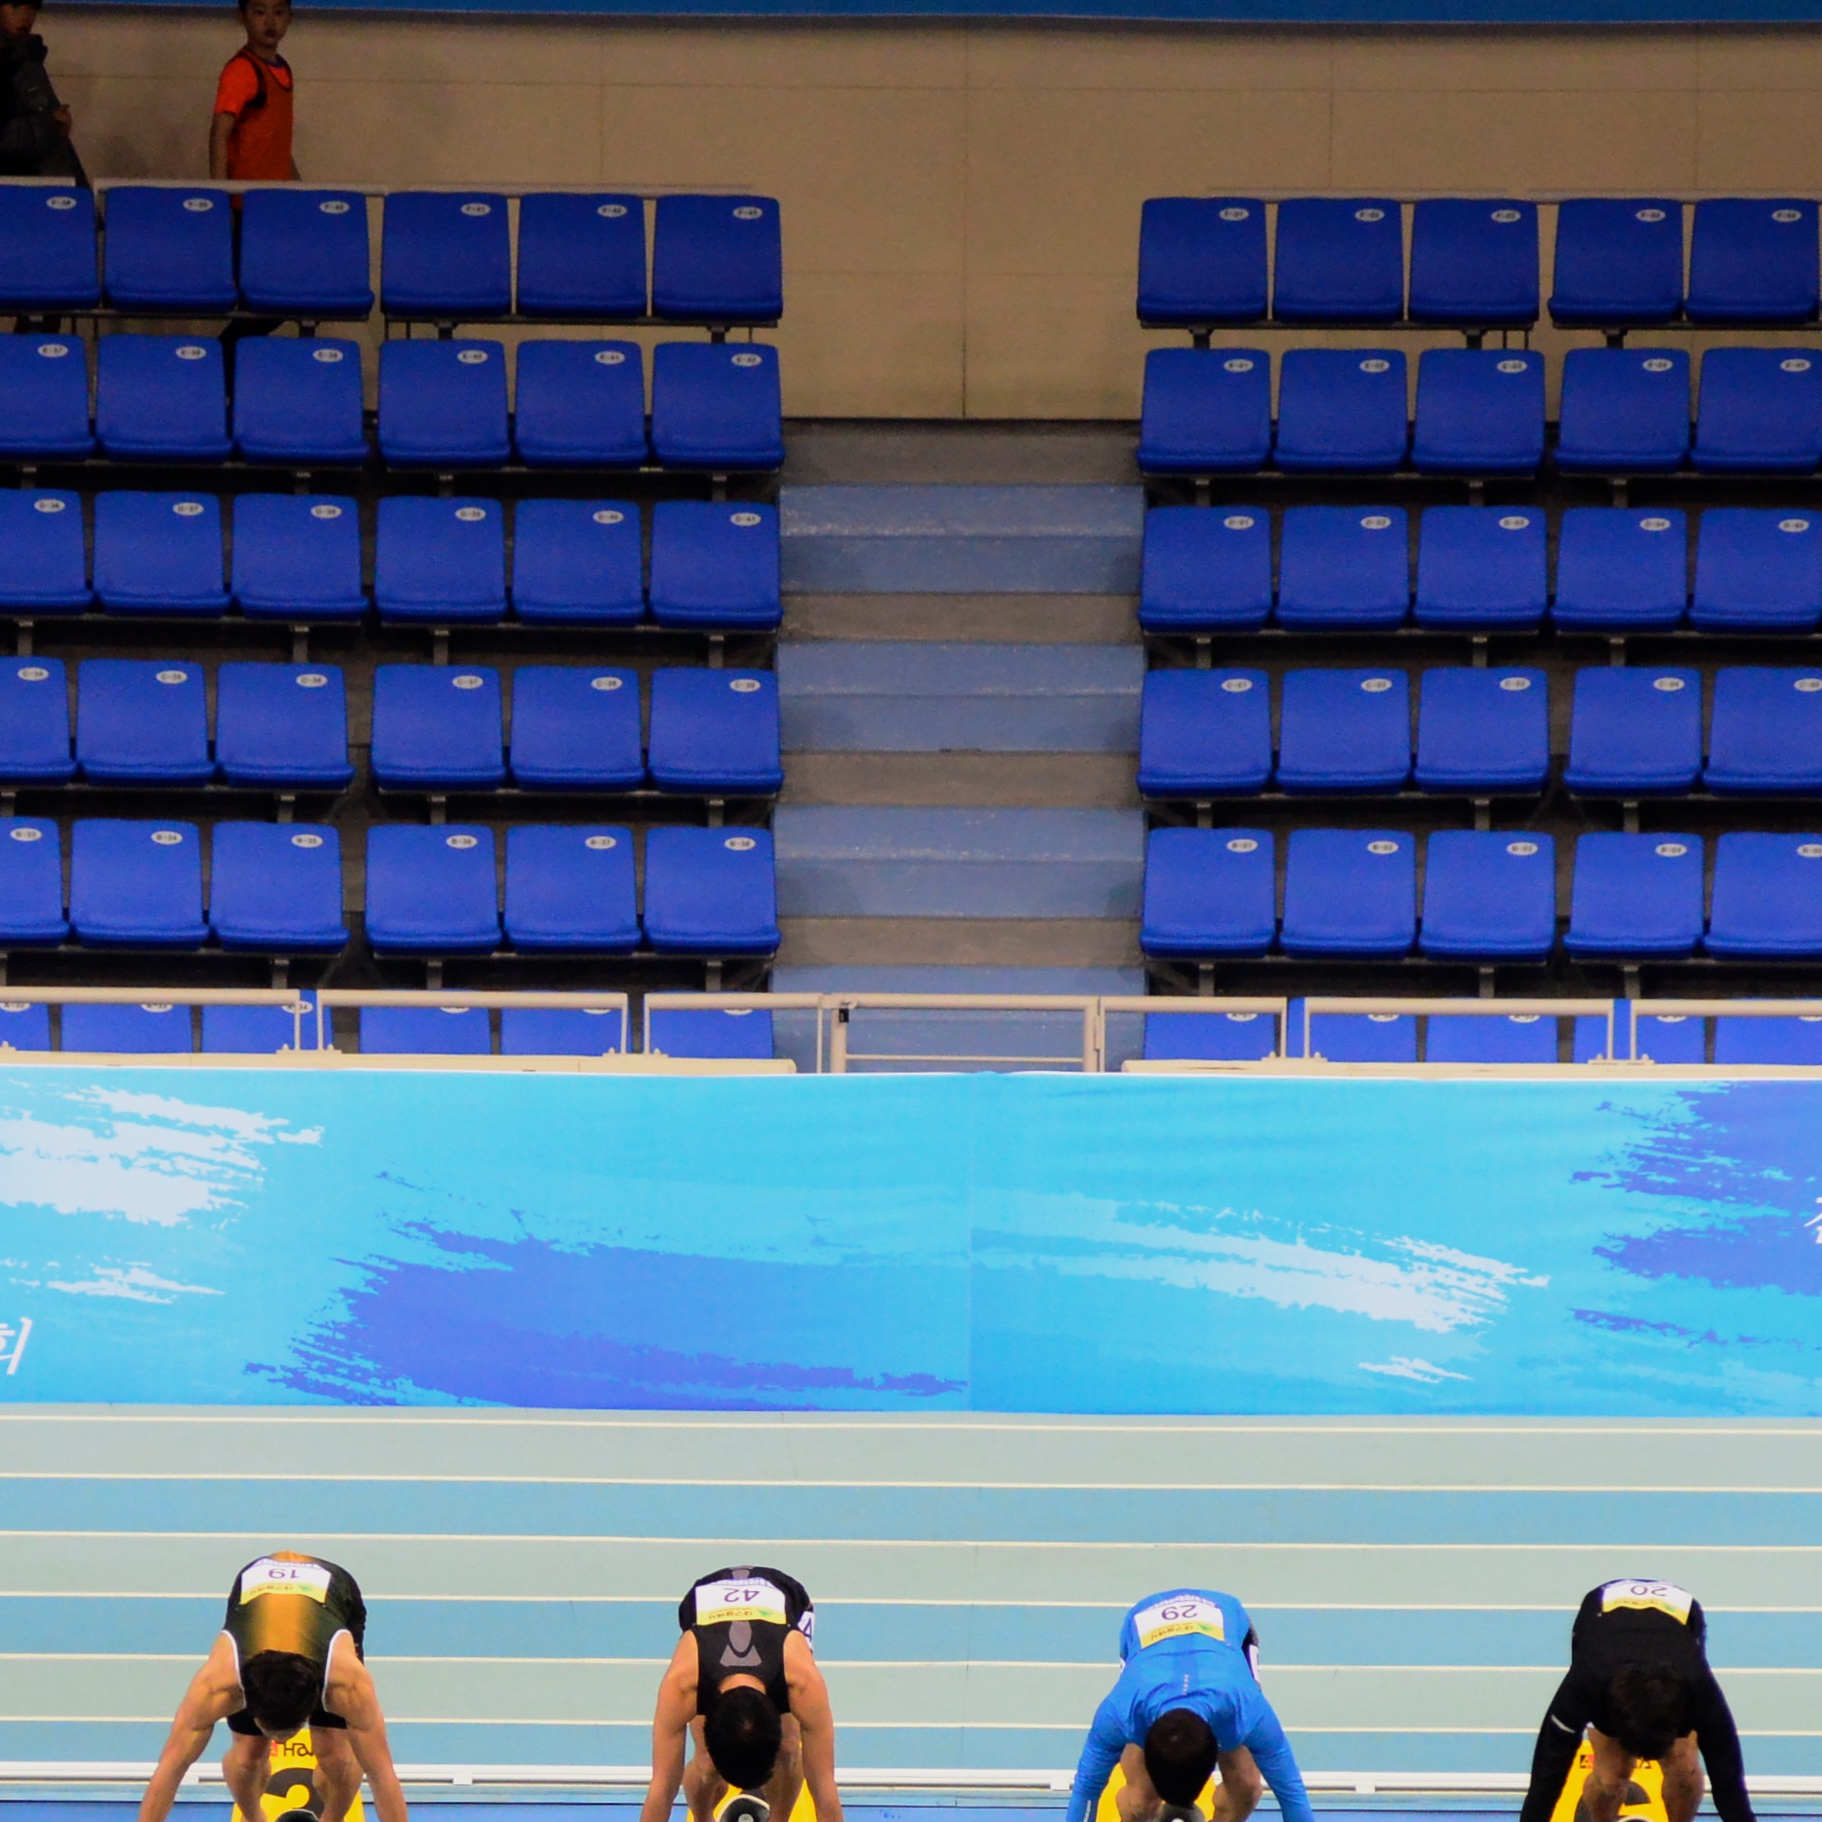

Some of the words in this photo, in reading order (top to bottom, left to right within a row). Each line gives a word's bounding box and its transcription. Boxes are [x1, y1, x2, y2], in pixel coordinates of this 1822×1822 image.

[267, 1568, 300, 1580] 19
[723, 1587, 761, 1603] 42
[1630, 1584, 1668, 1598] 20
[1160, 1603, 1199, 1622] 29
